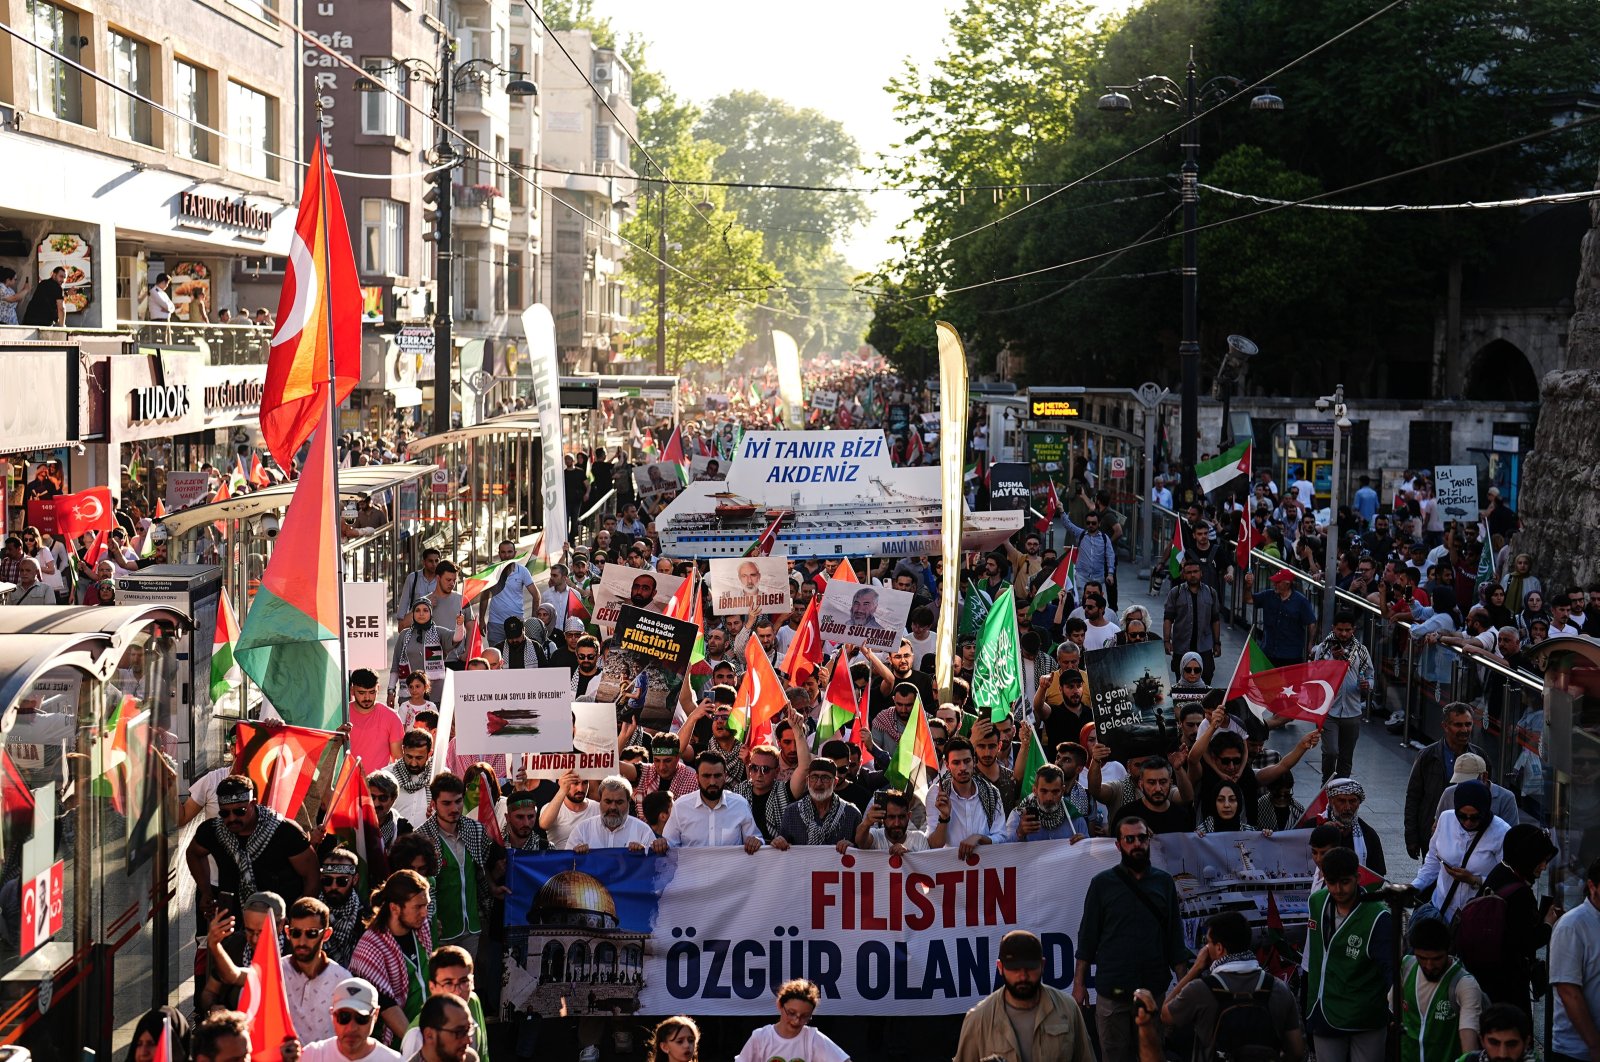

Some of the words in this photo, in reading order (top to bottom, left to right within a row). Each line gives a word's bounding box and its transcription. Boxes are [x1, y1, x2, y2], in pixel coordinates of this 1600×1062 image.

[138, 385, 190, 420] TUDORS
[744, 437, 772, 458] İYİ
[775, 441, 836, 459] TANIR
[840, 436, 884, 458] BİZİ
[766, 461, 860, 483] AKDENİZ
[1449, 478, 1475, 488] TANIR
[992, 488, 1030, 498] HAYKIR!
[882, 539, 907, 554] MAVİ
[909, 540, 941, 553] MARM
[719, 595, 754, 609] İBRAHİM
[346, 616, 378, 628] REE
[636, 623, 655, 633] olana
[655, 627, 675, 638] kadar
[639, 616, 656, 626] Aksa
[656, 620, 676, 631] özgür
[820, 620, 846, 634] UĞUR
[848, 624, 897, 640] SÜLEYMAN
[624, 628, 680, 652] Filistin'in
[866, 638, 895, 648] SÖYLEMEZ
[621, 641, 677, 662] yanındayız!
[477, 693, 493, 702] LAZIM
[494, 693, 508, 701] OLAN
[509, 692, 526, 700] SOYLU
[527, 690, 537, 700] BİR
[1095, 693, 1103, 702] o
[1105, 684, 1128, 703] gemi
[1097, 704, 1111, 715] bir
[1114, 700, 1132, 715] gün
[1100, 710, 1143, 734] gelecek!
[532, 753, 576, 770] HAYDAR
[579, 750, 615, 768] BENGİ
[812, 853, 1017, 931] FİLİSTİN
[666, 925, 842, 1000] ÖZGÜR
[856, 936, 1005, 1000] OLAN
